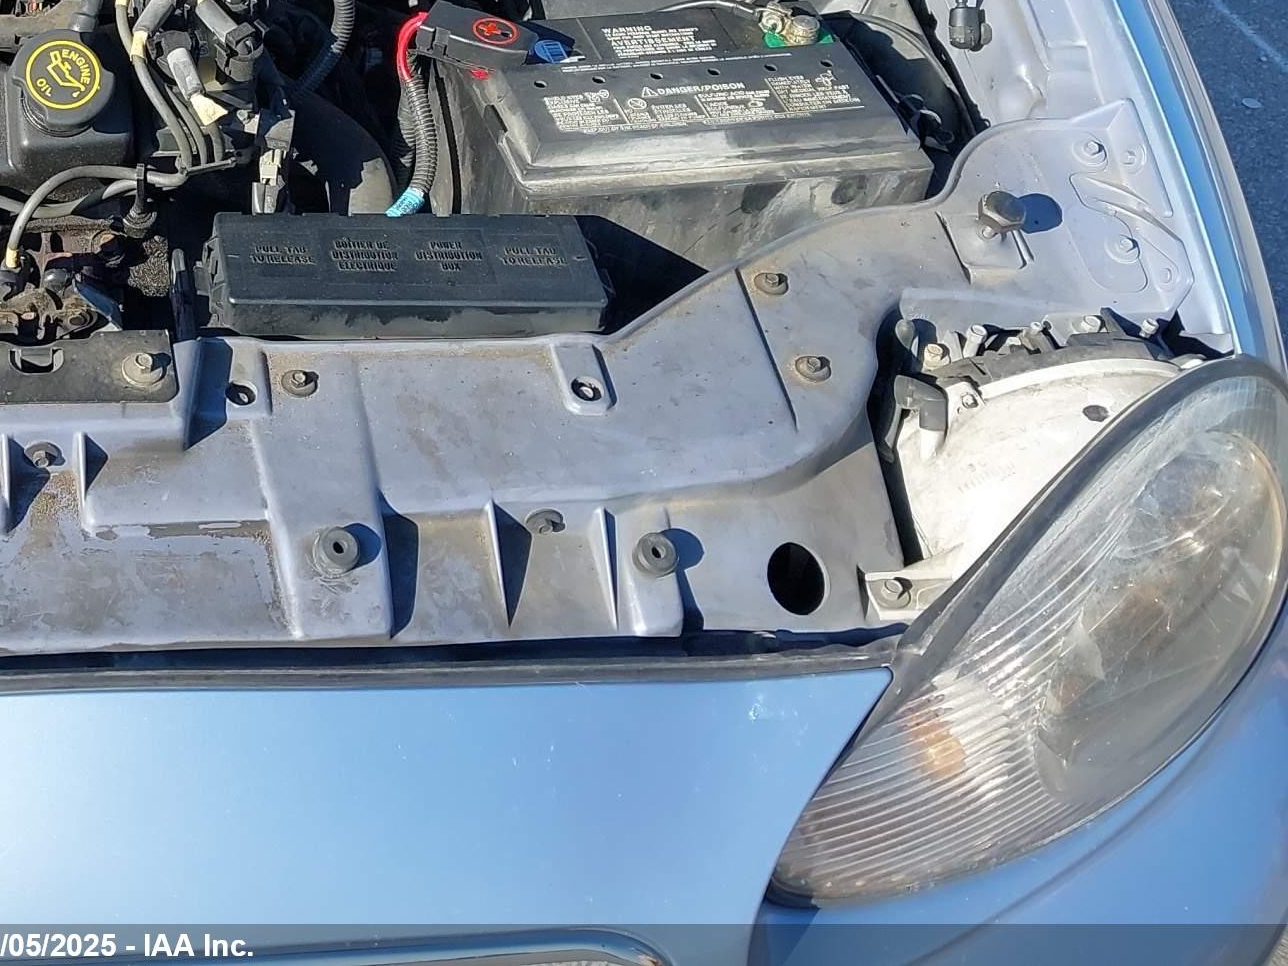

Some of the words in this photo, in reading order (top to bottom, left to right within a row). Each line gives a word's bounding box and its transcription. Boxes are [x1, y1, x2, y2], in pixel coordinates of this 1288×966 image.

[601, 25, 653, 35] WARNING
[611, 35, 696, 47] AVERTISSEMENT
[61, 48, 91, 85] ENGINE
[35, 78, 53, 97] OIL
[657, 82, 746, 96] DANGER/POISON
[254, 245, 282, 254] PULL
[284, 246, 307, 255] TAB
[428, 241, 463, 251] POWER
[503, 246, 531, 256] PULL
[534, 247, 557, 256] TAB
[249, 254, 265, 264] TO
[265, 255, 317, 265] RELEASE
[330, 250, 399, 261] DISTRIBUTION
[414, 250, 483, 261] DISTRIBUTION
[439, 261, 461, 272] BOX
[502, 256, 516, 266] TO
[516, 257, 569, 267] RELEASE
